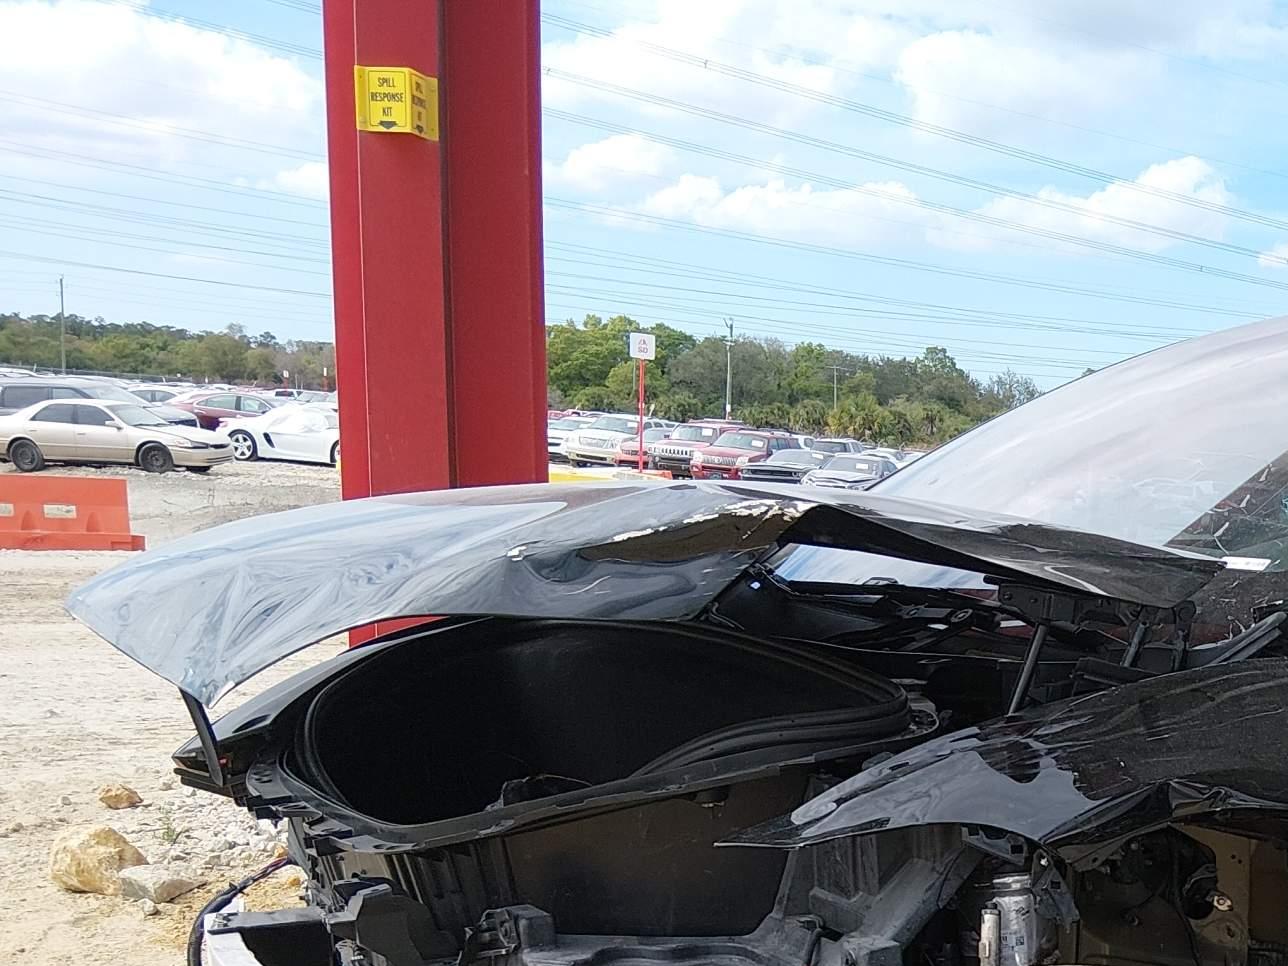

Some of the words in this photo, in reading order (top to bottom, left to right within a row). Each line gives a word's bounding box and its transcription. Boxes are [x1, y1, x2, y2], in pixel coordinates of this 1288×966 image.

[377, 77, 396, 88] SPILL
[370, 91, 404, 103] RESPONSE
[382, 106, 393, 117] KIT
